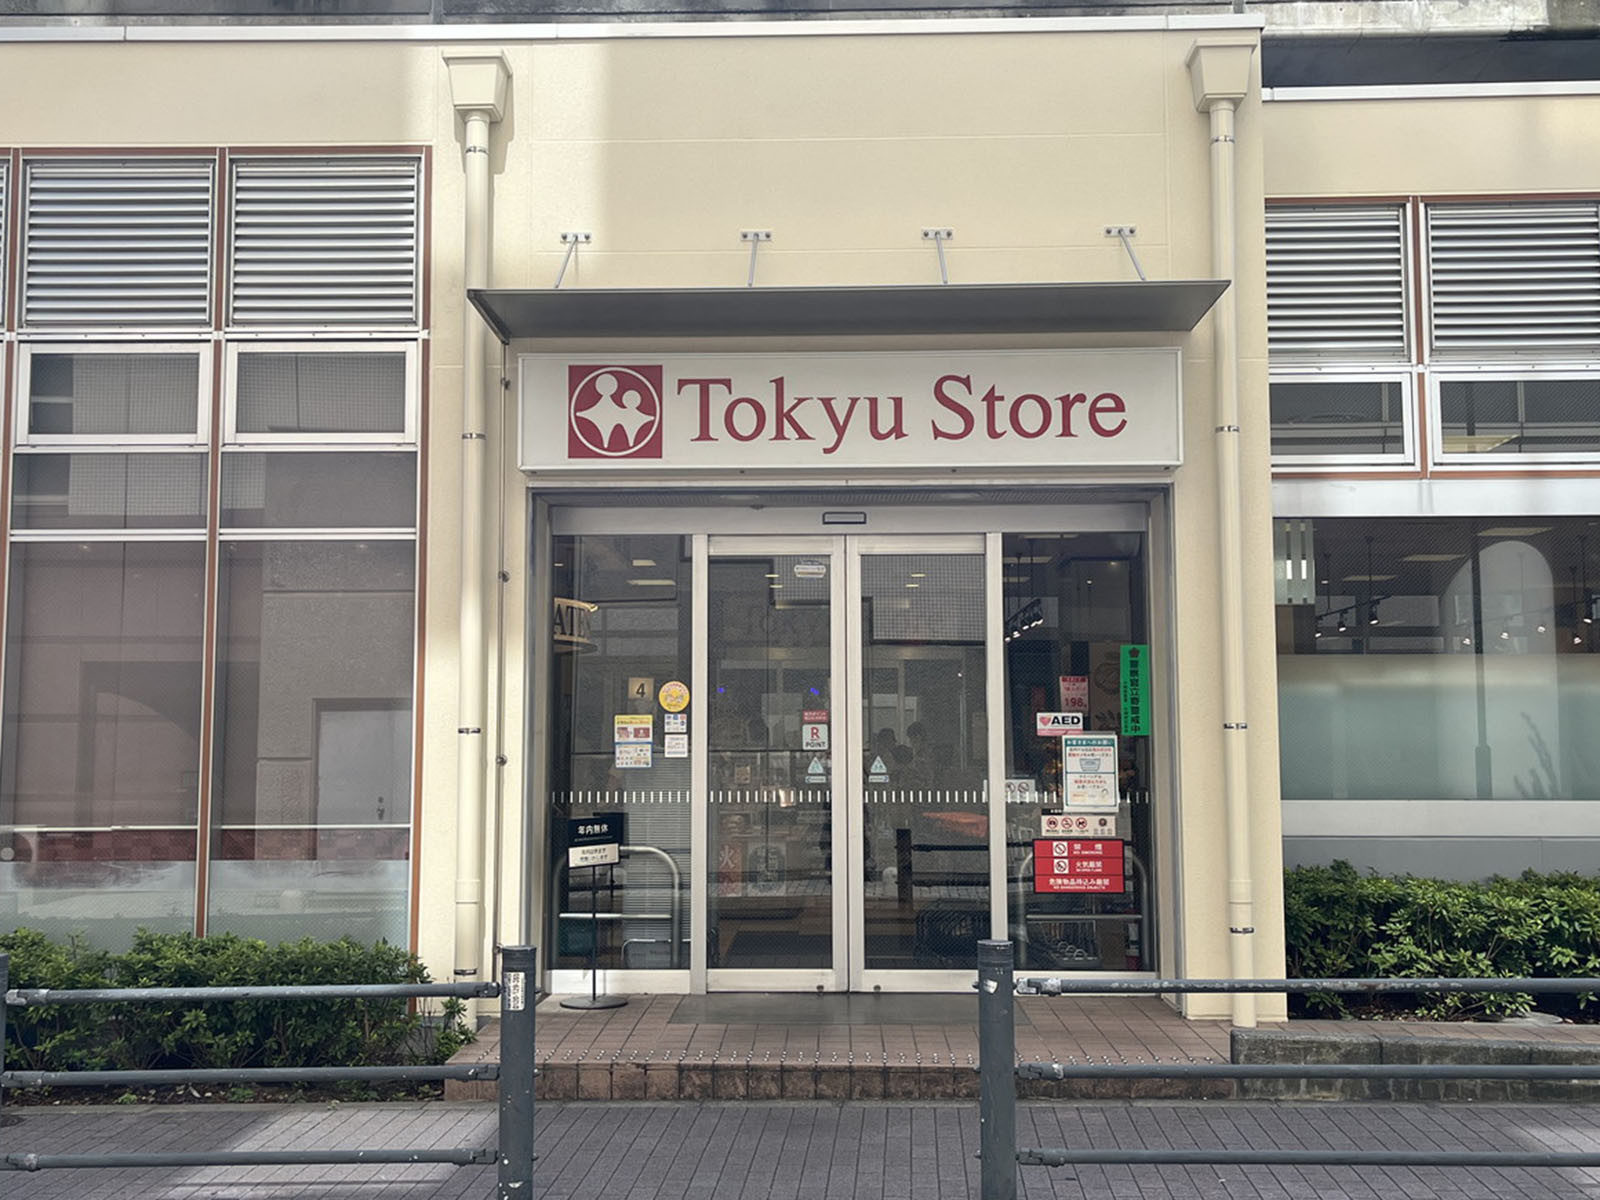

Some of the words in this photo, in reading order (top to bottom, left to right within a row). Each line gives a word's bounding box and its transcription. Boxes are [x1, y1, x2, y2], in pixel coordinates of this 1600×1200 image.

[677, 377, 909, 454] Tokyu
[932, 375, 1128, 440] Store
[636, 683, 646, 698] 4
[1051, 716, 1081, 725] AED
[811, 727, 820, 739] R
[577, 824, 609, 835] 年内無休
